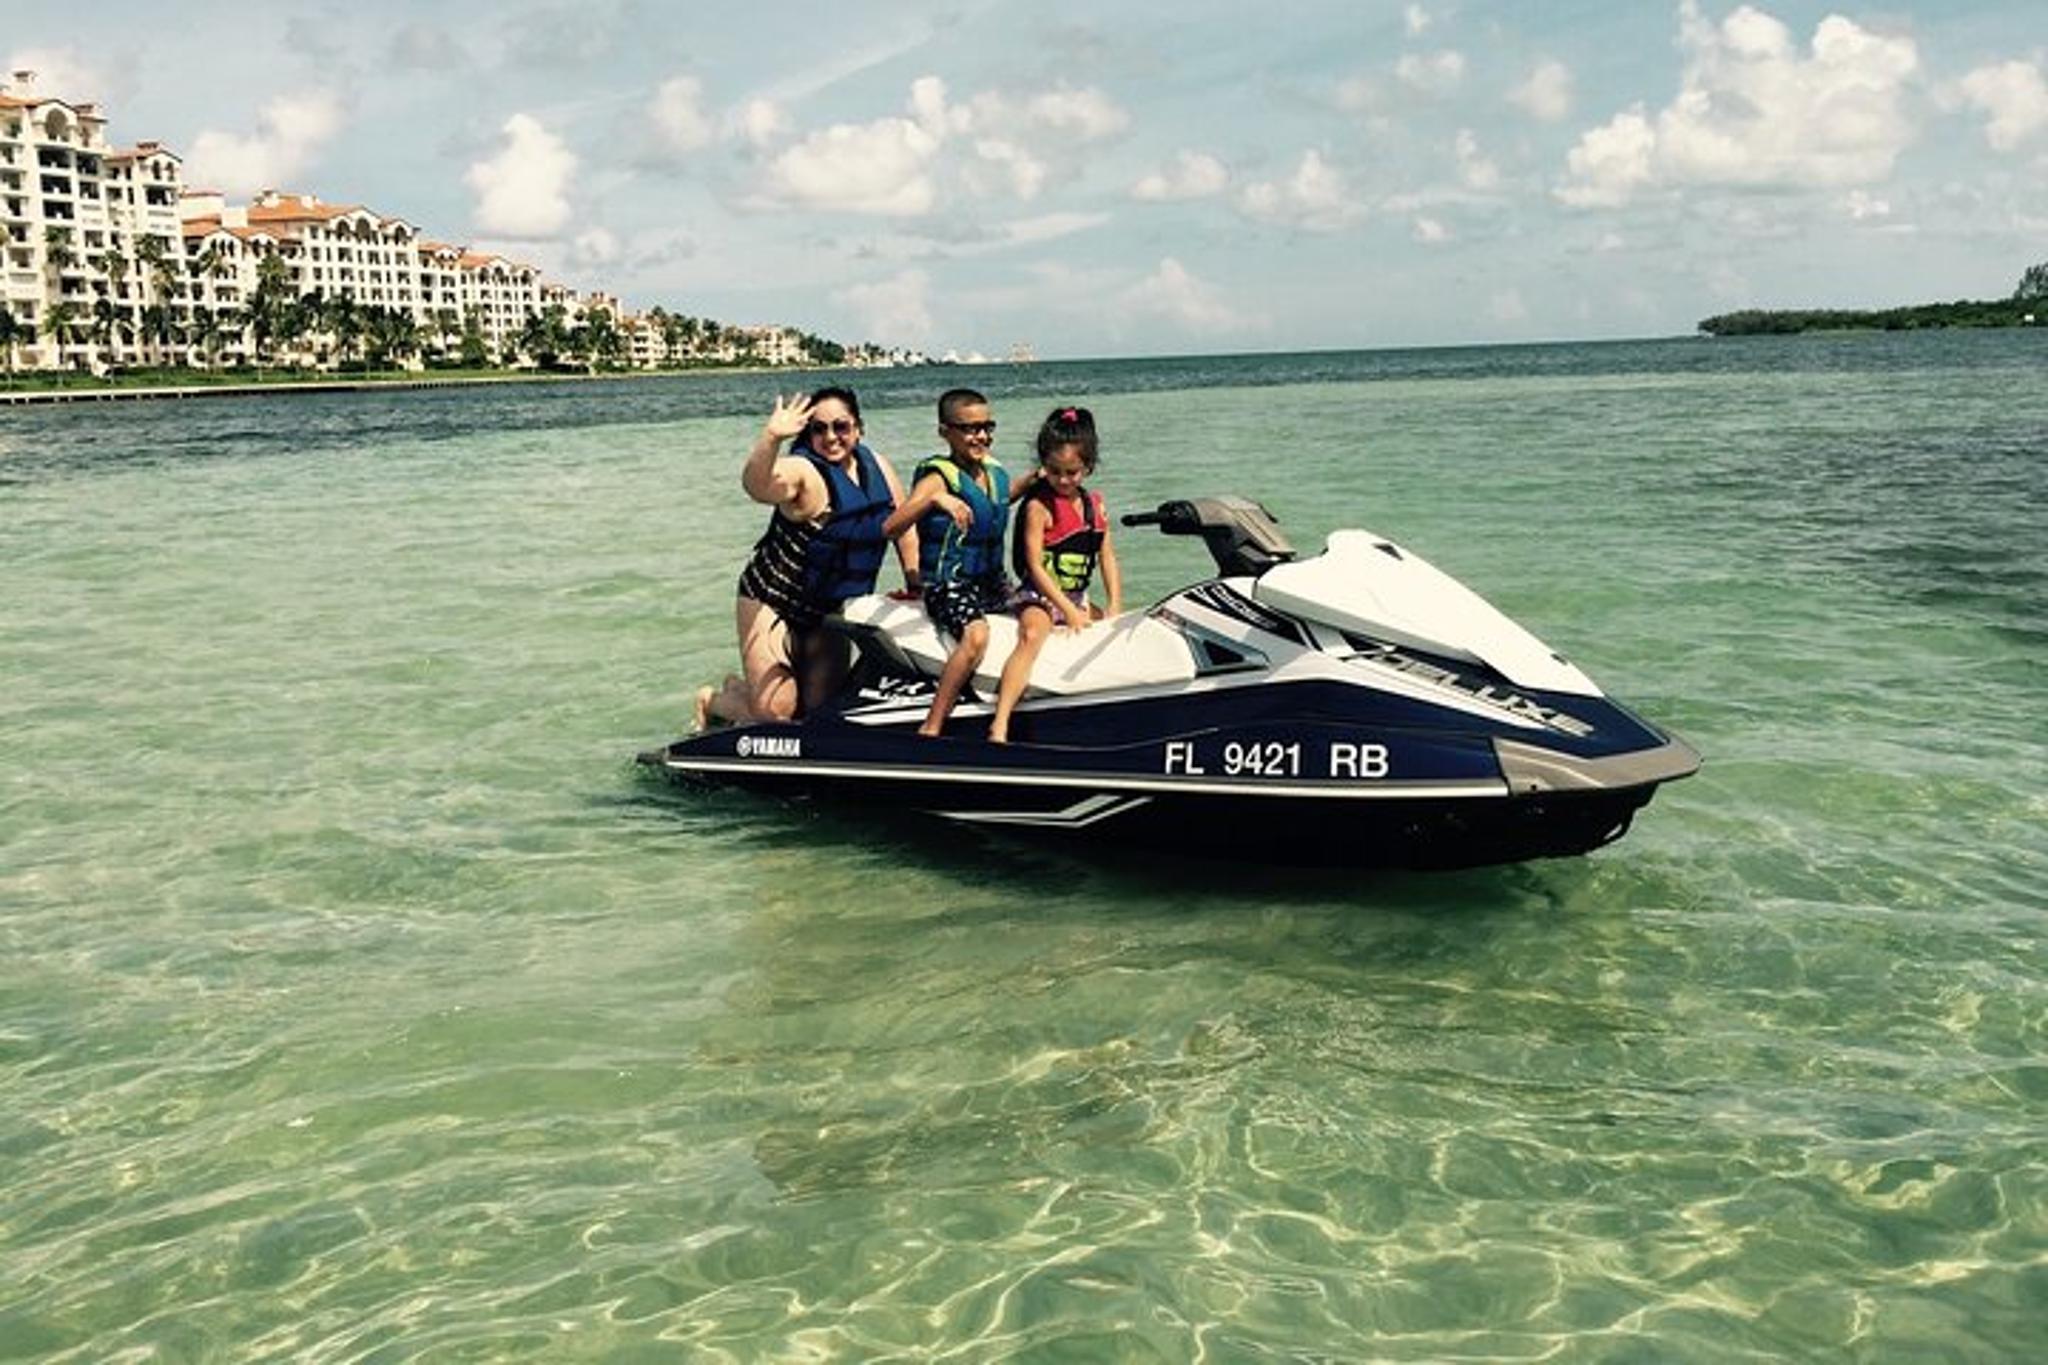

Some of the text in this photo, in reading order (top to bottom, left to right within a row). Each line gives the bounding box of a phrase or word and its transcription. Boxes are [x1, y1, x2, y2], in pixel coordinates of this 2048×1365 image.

[753, 737, 801, 757] YAMAHA
[1165, 742, 1389, 777] FL 9421 RB
